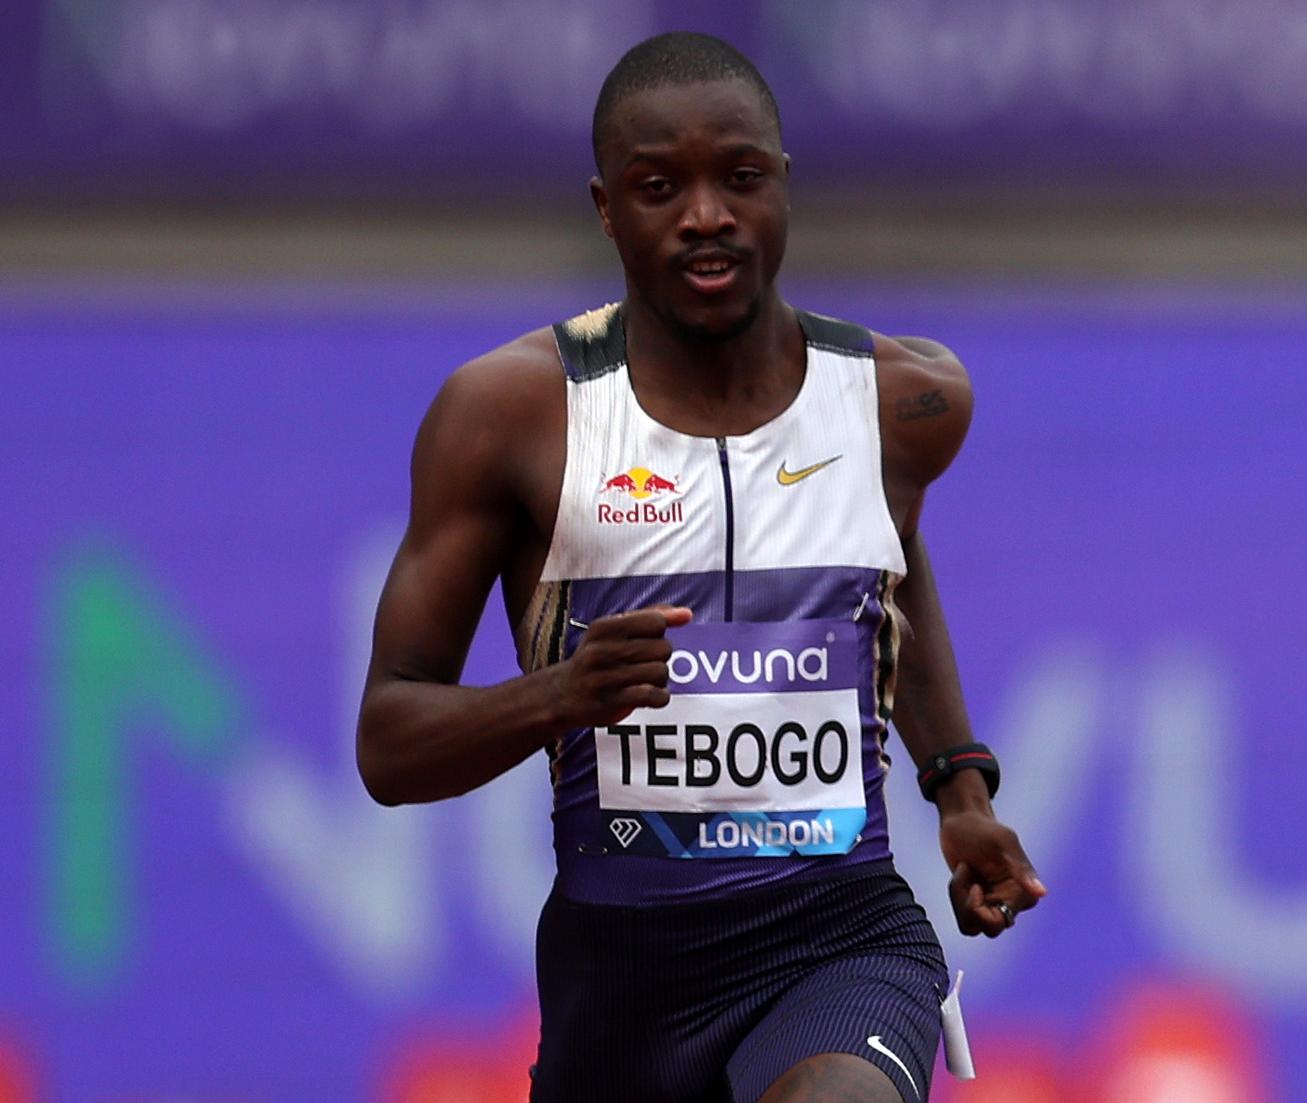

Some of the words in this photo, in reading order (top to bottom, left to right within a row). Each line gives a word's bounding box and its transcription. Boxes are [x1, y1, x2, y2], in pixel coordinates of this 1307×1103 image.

[598, 502, 639, 523] Red
[644, 502, 683, 523] Bull
[666, 646, 829, 684] ovuna
[607, 720, 849, 787] TEBOGO
[698, 818, 834, 849] LONDON
